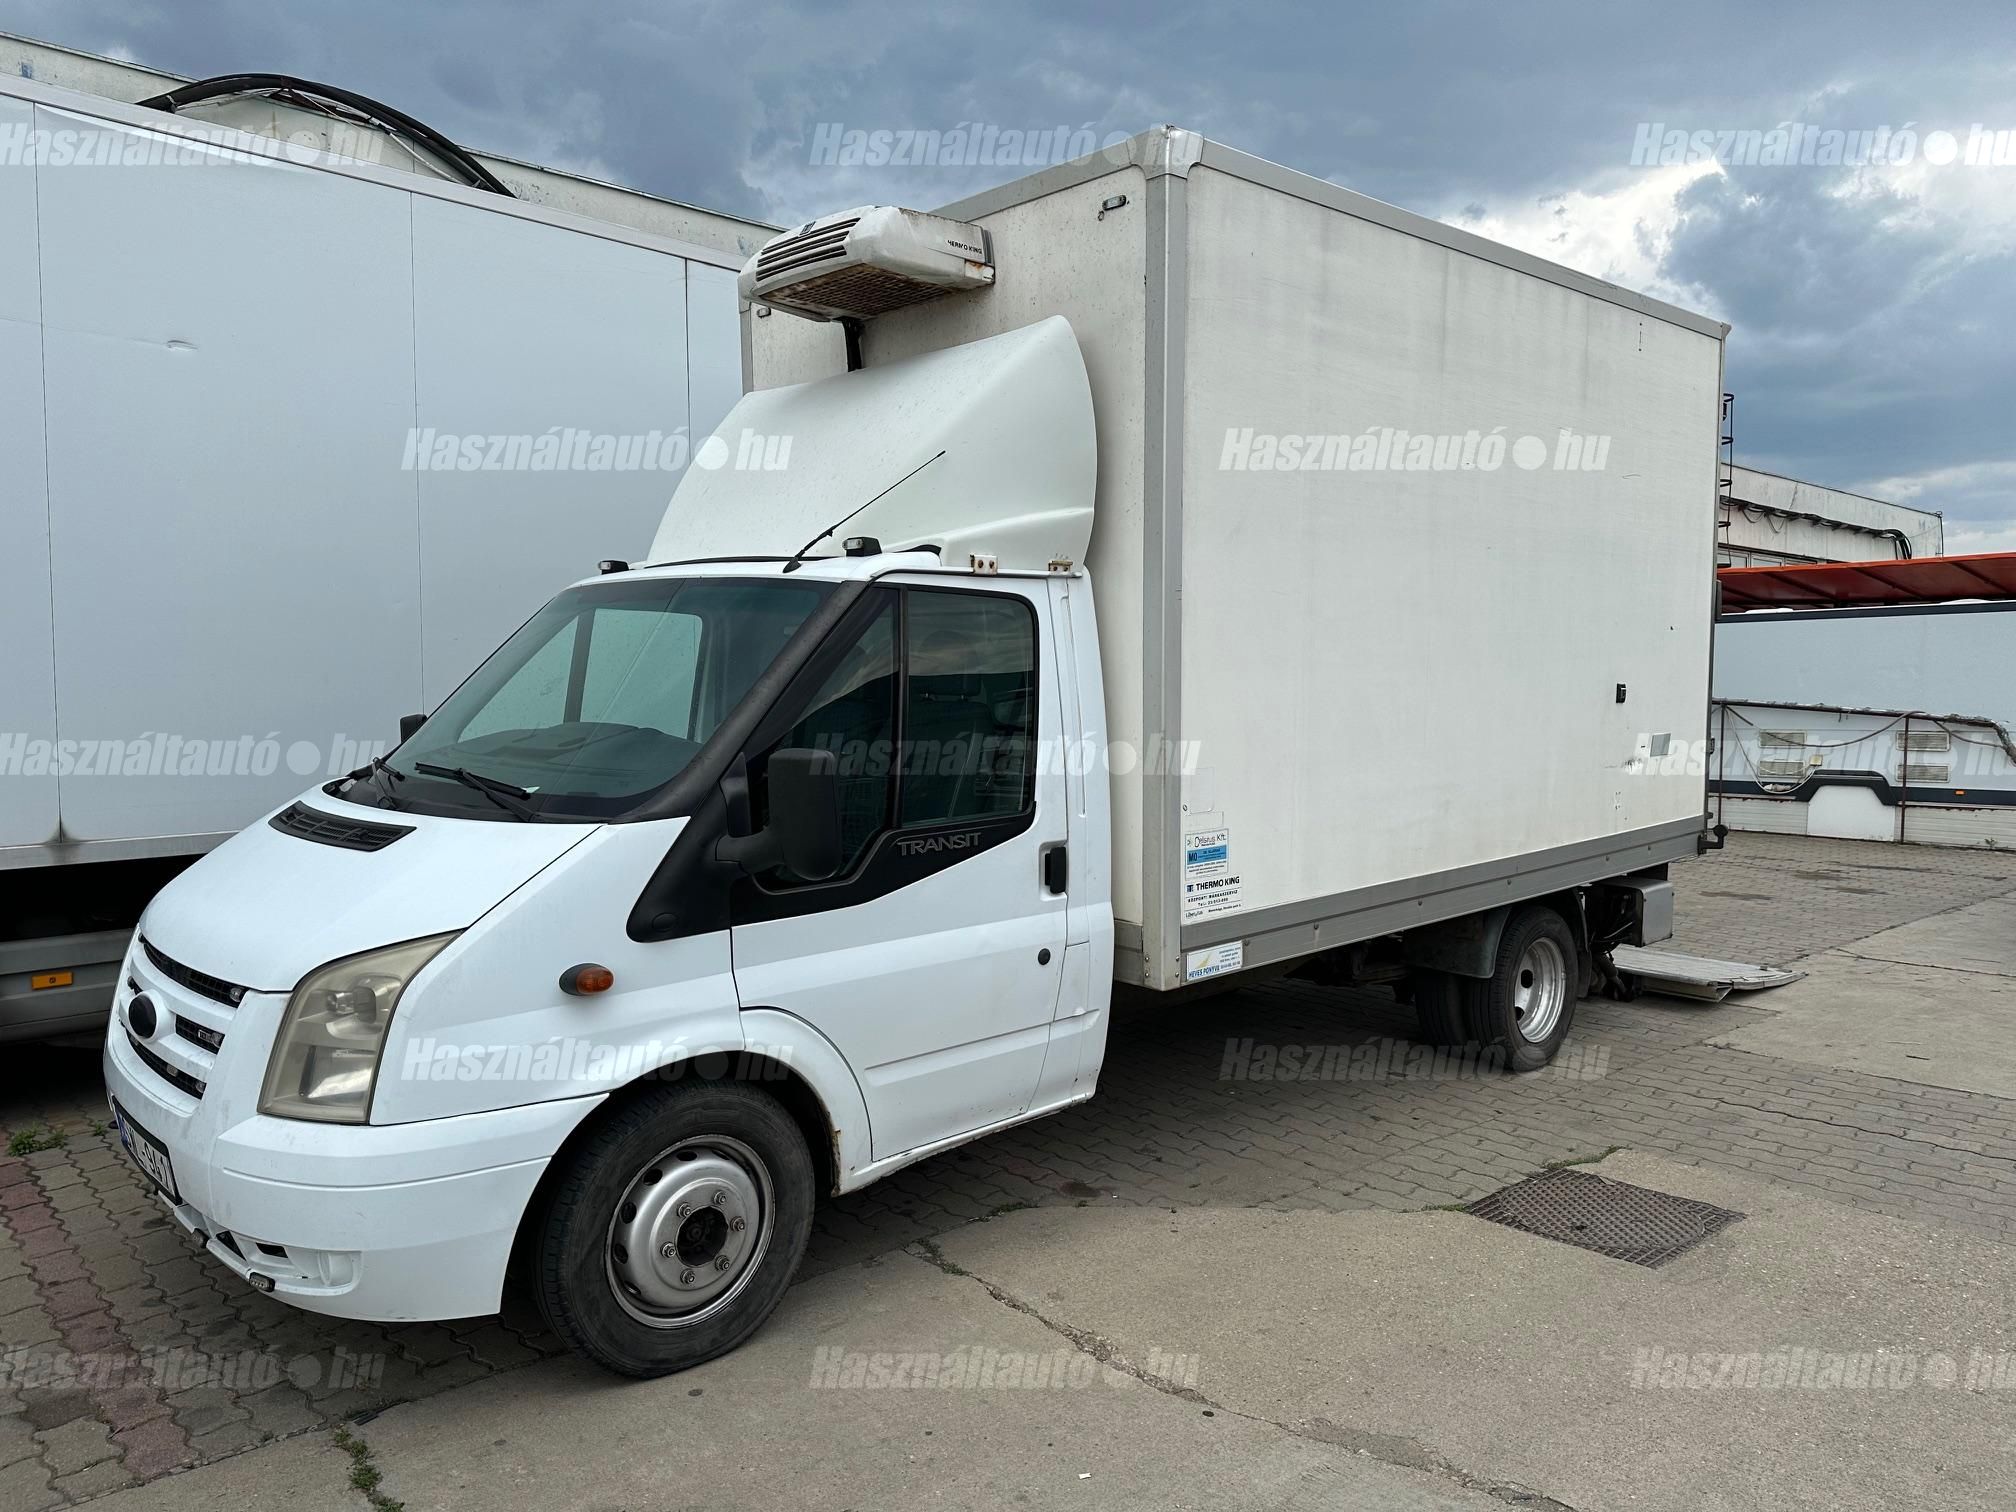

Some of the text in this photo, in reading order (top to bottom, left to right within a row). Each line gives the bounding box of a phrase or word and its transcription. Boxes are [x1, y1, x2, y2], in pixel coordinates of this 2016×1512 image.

[897, 832, 982, 856] TRANSIT
[1196, 876, 1240, 891] THERMO KING
